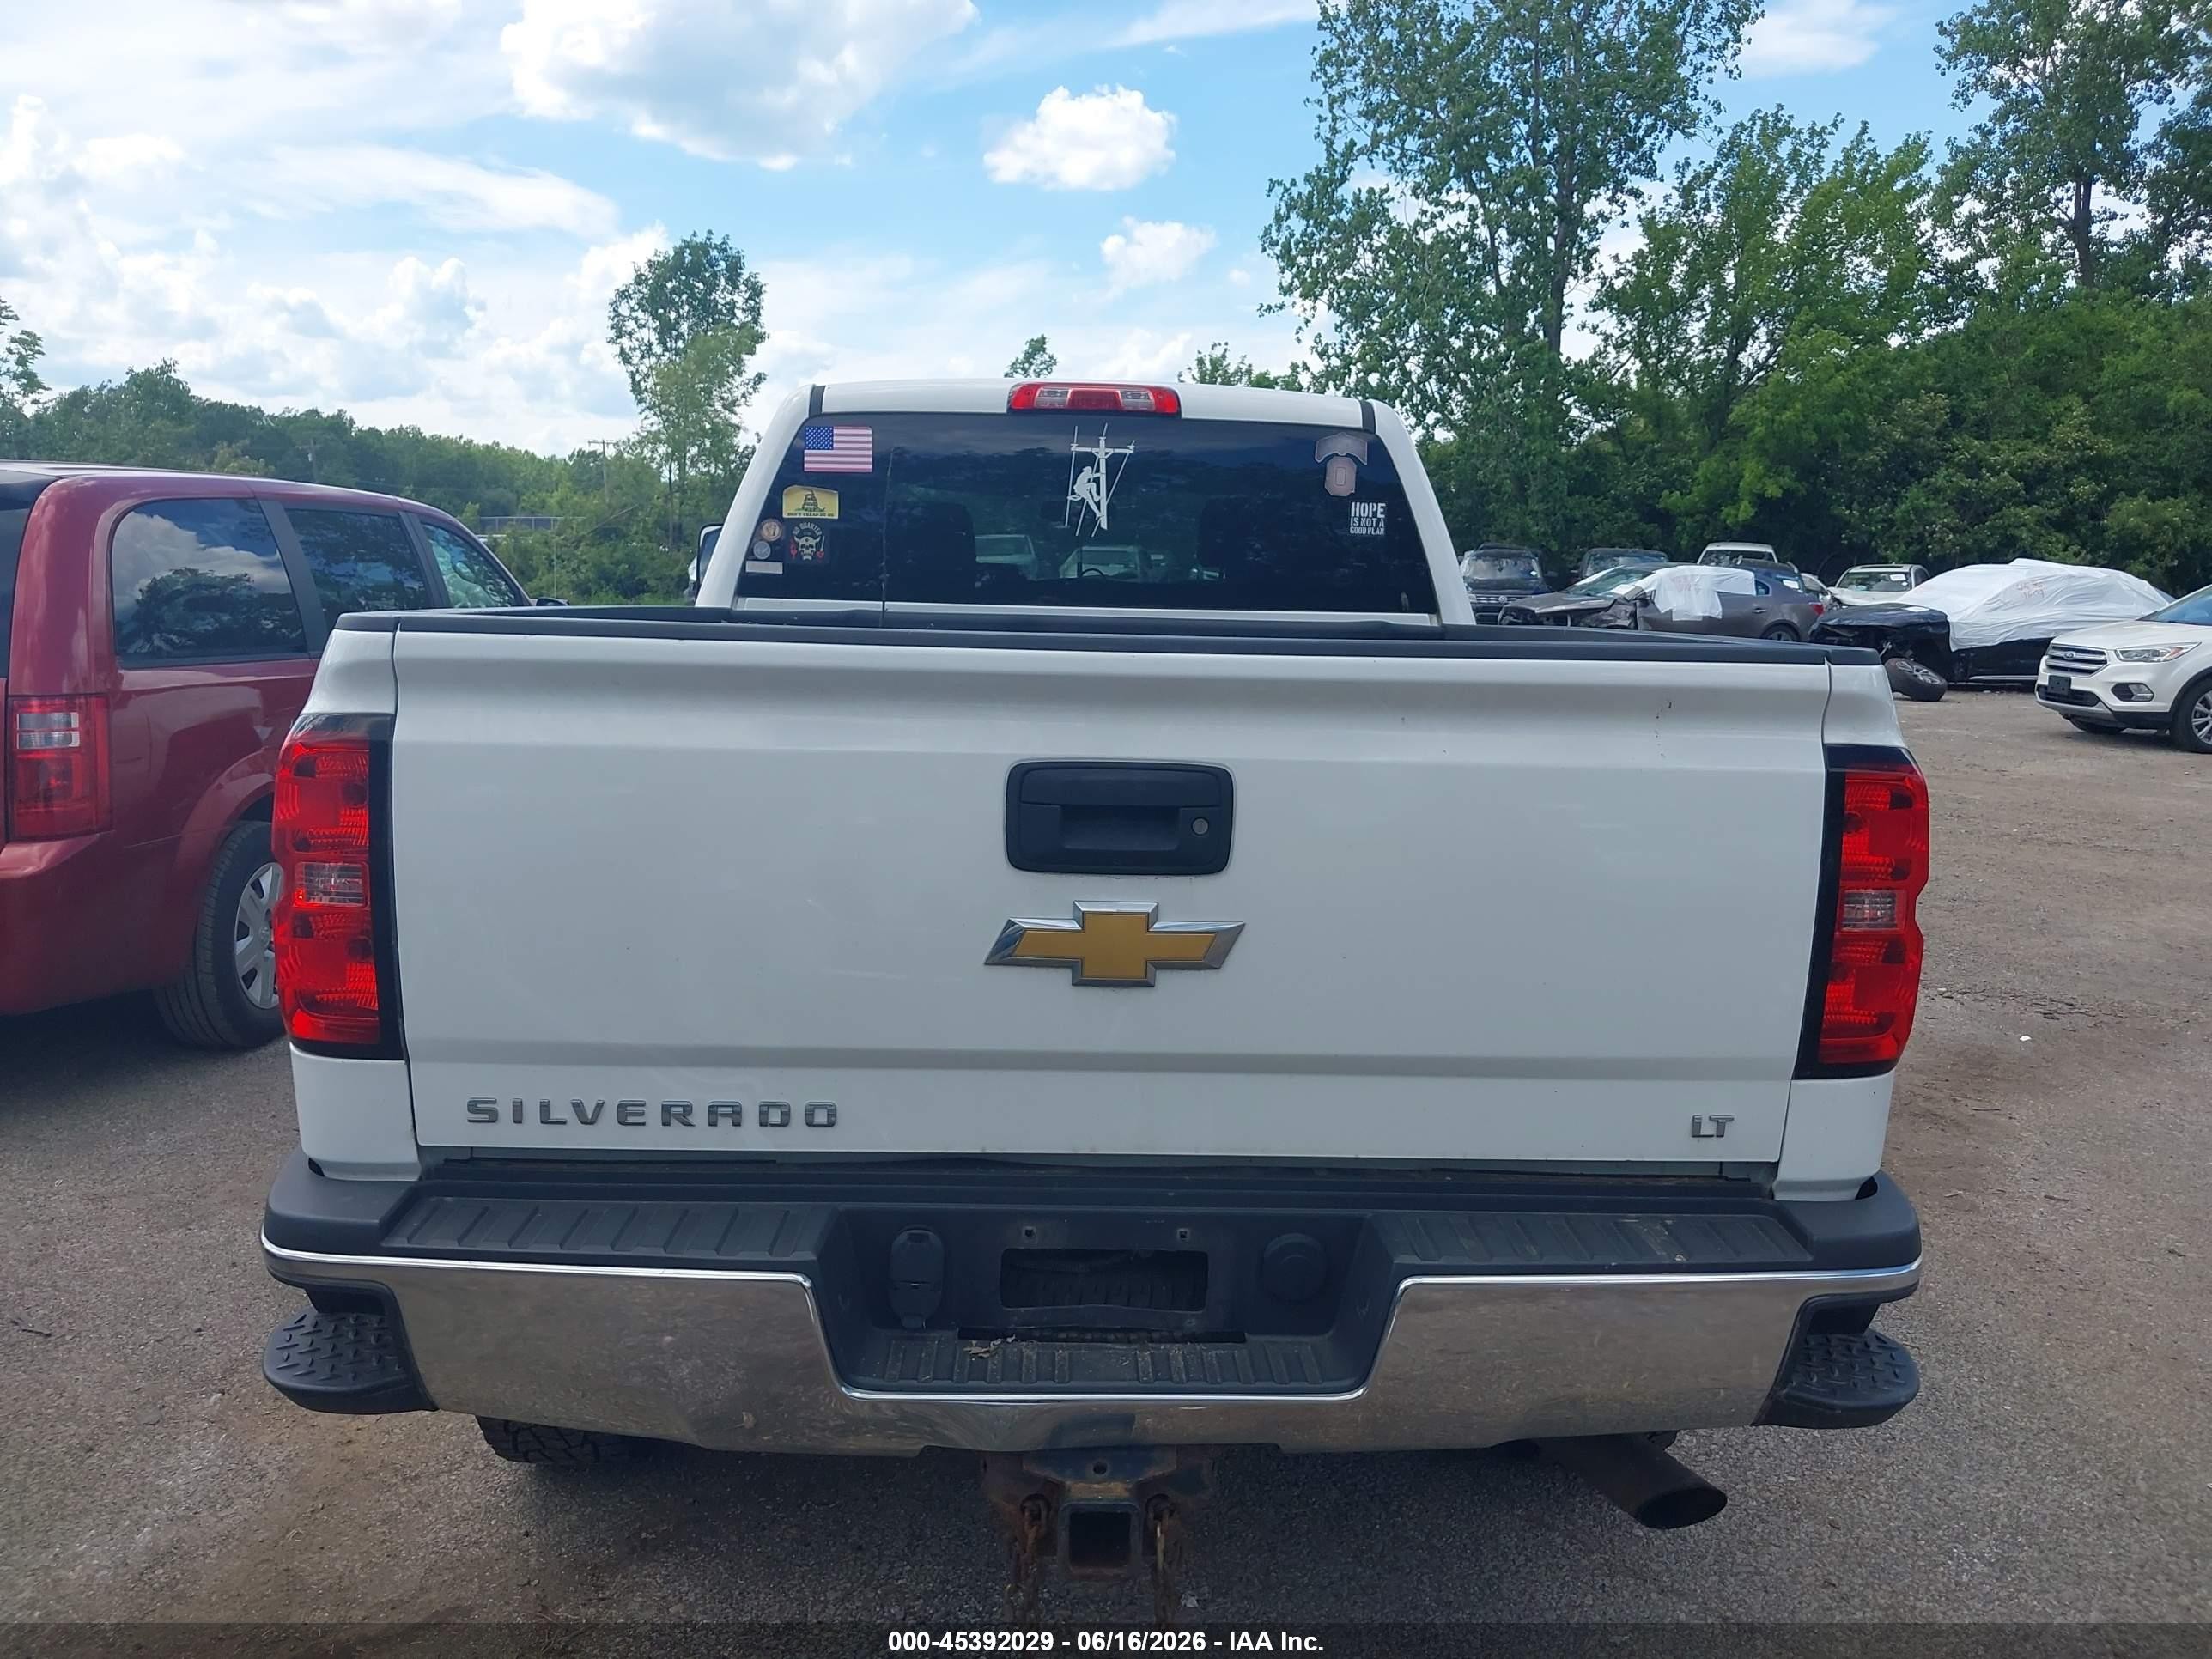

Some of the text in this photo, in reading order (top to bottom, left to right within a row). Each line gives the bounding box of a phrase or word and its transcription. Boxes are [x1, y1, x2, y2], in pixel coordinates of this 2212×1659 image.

[1351, 501, 1386, 518] HOPE
[1350, 517, 1385, 527] IS NOT A
[1367, 526, 1385, 535] PLAN
[466, 1097, 838, 1128] SILVERADO
[1691, 1114, 1735, 1139] LT
